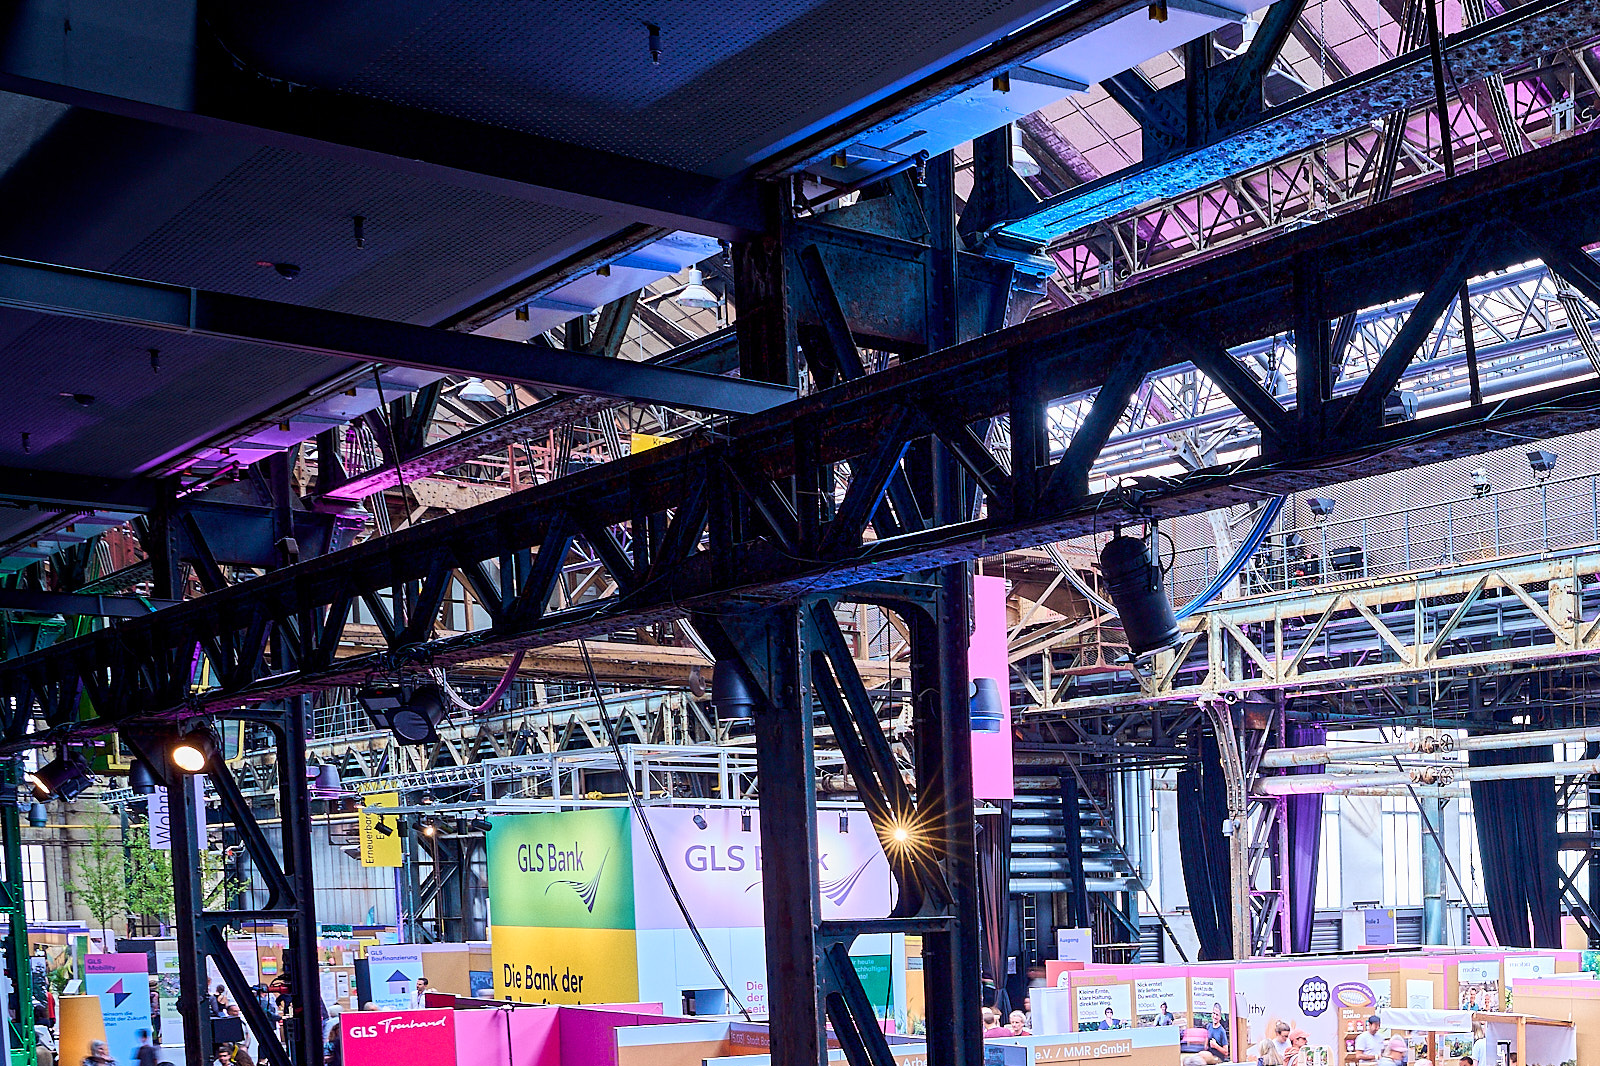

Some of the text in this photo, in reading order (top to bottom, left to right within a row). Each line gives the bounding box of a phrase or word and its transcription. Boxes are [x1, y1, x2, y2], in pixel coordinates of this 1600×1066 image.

[517, 842, 585, 873] GLS Bank
[685, 845, 746, 872] GLS
[504, 963, 584, 993] Die Bank der
[746, 981, 764, 991] Die
[1302, 981, 1327, 993] GOOD
[746, 992, 765, 1002] der
[1301, 991, 1329, 1002] MOOD
[1302, 1000, 1327, 1012] FOOD
[350, 1015, 446, 1039] GLS Treuhand
[1035, 1048, 1053, 1060] e.V.
[1063, 1045, 1091, 1058] MMR
[1093, 1042, 1130, 1057] gGmbH
